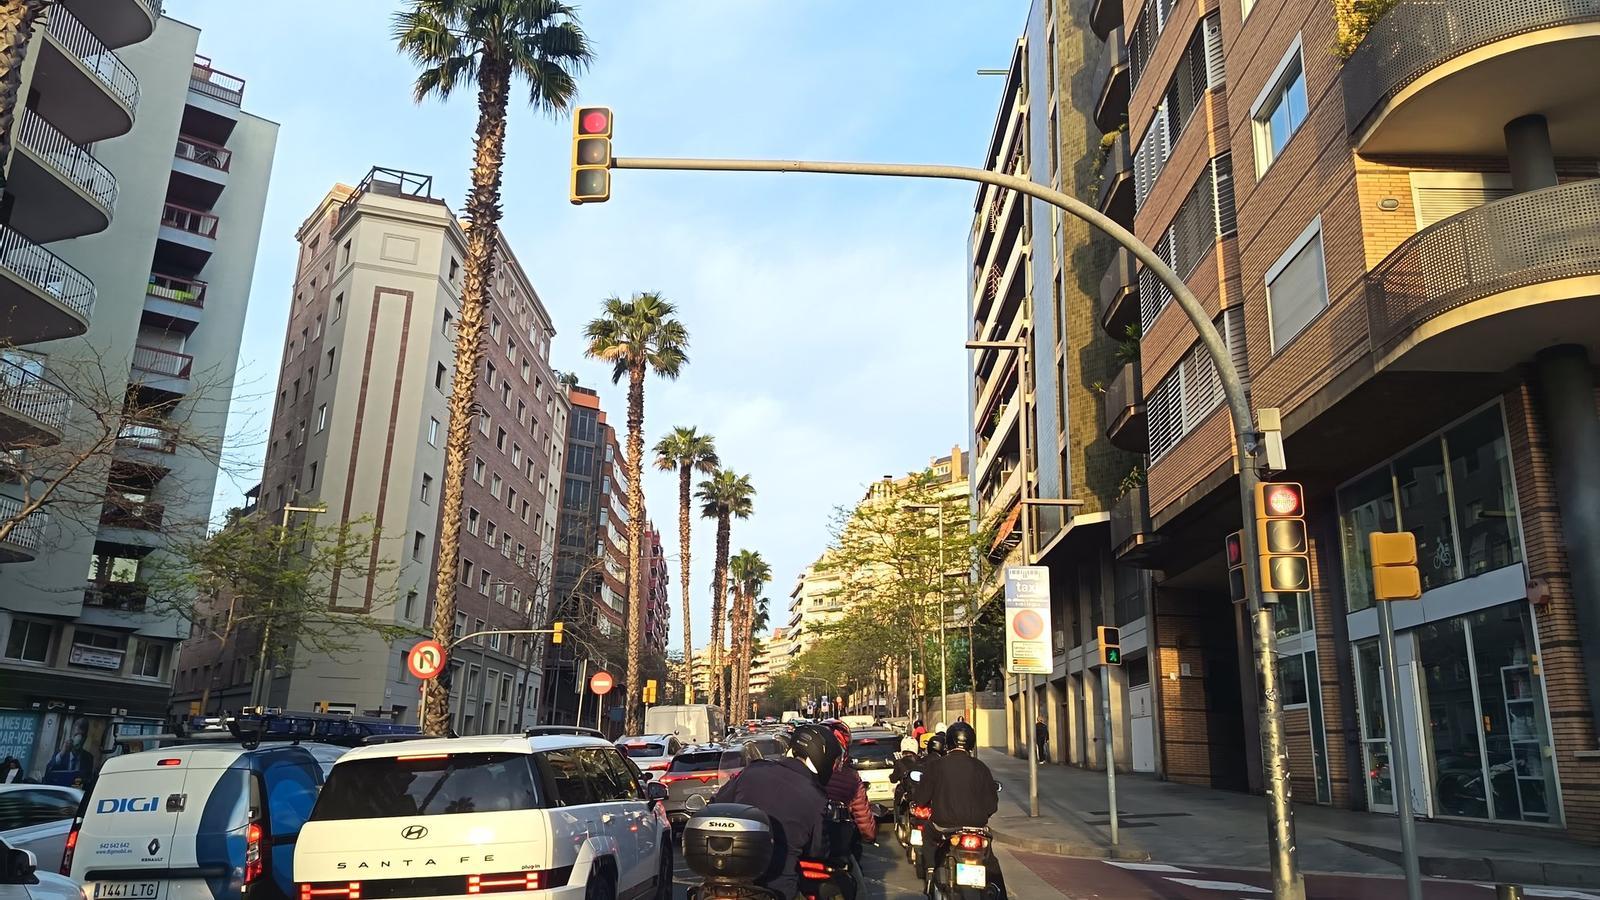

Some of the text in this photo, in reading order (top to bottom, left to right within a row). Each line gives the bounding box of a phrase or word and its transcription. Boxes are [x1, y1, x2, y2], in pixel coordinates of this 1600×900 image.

[21, 717, 34, 731] DE
[96, 797, 160, 814] DIGI
[337, 854, 494, 869] SANTA FE
[103, 883, 155, 896] 1441 LTG
